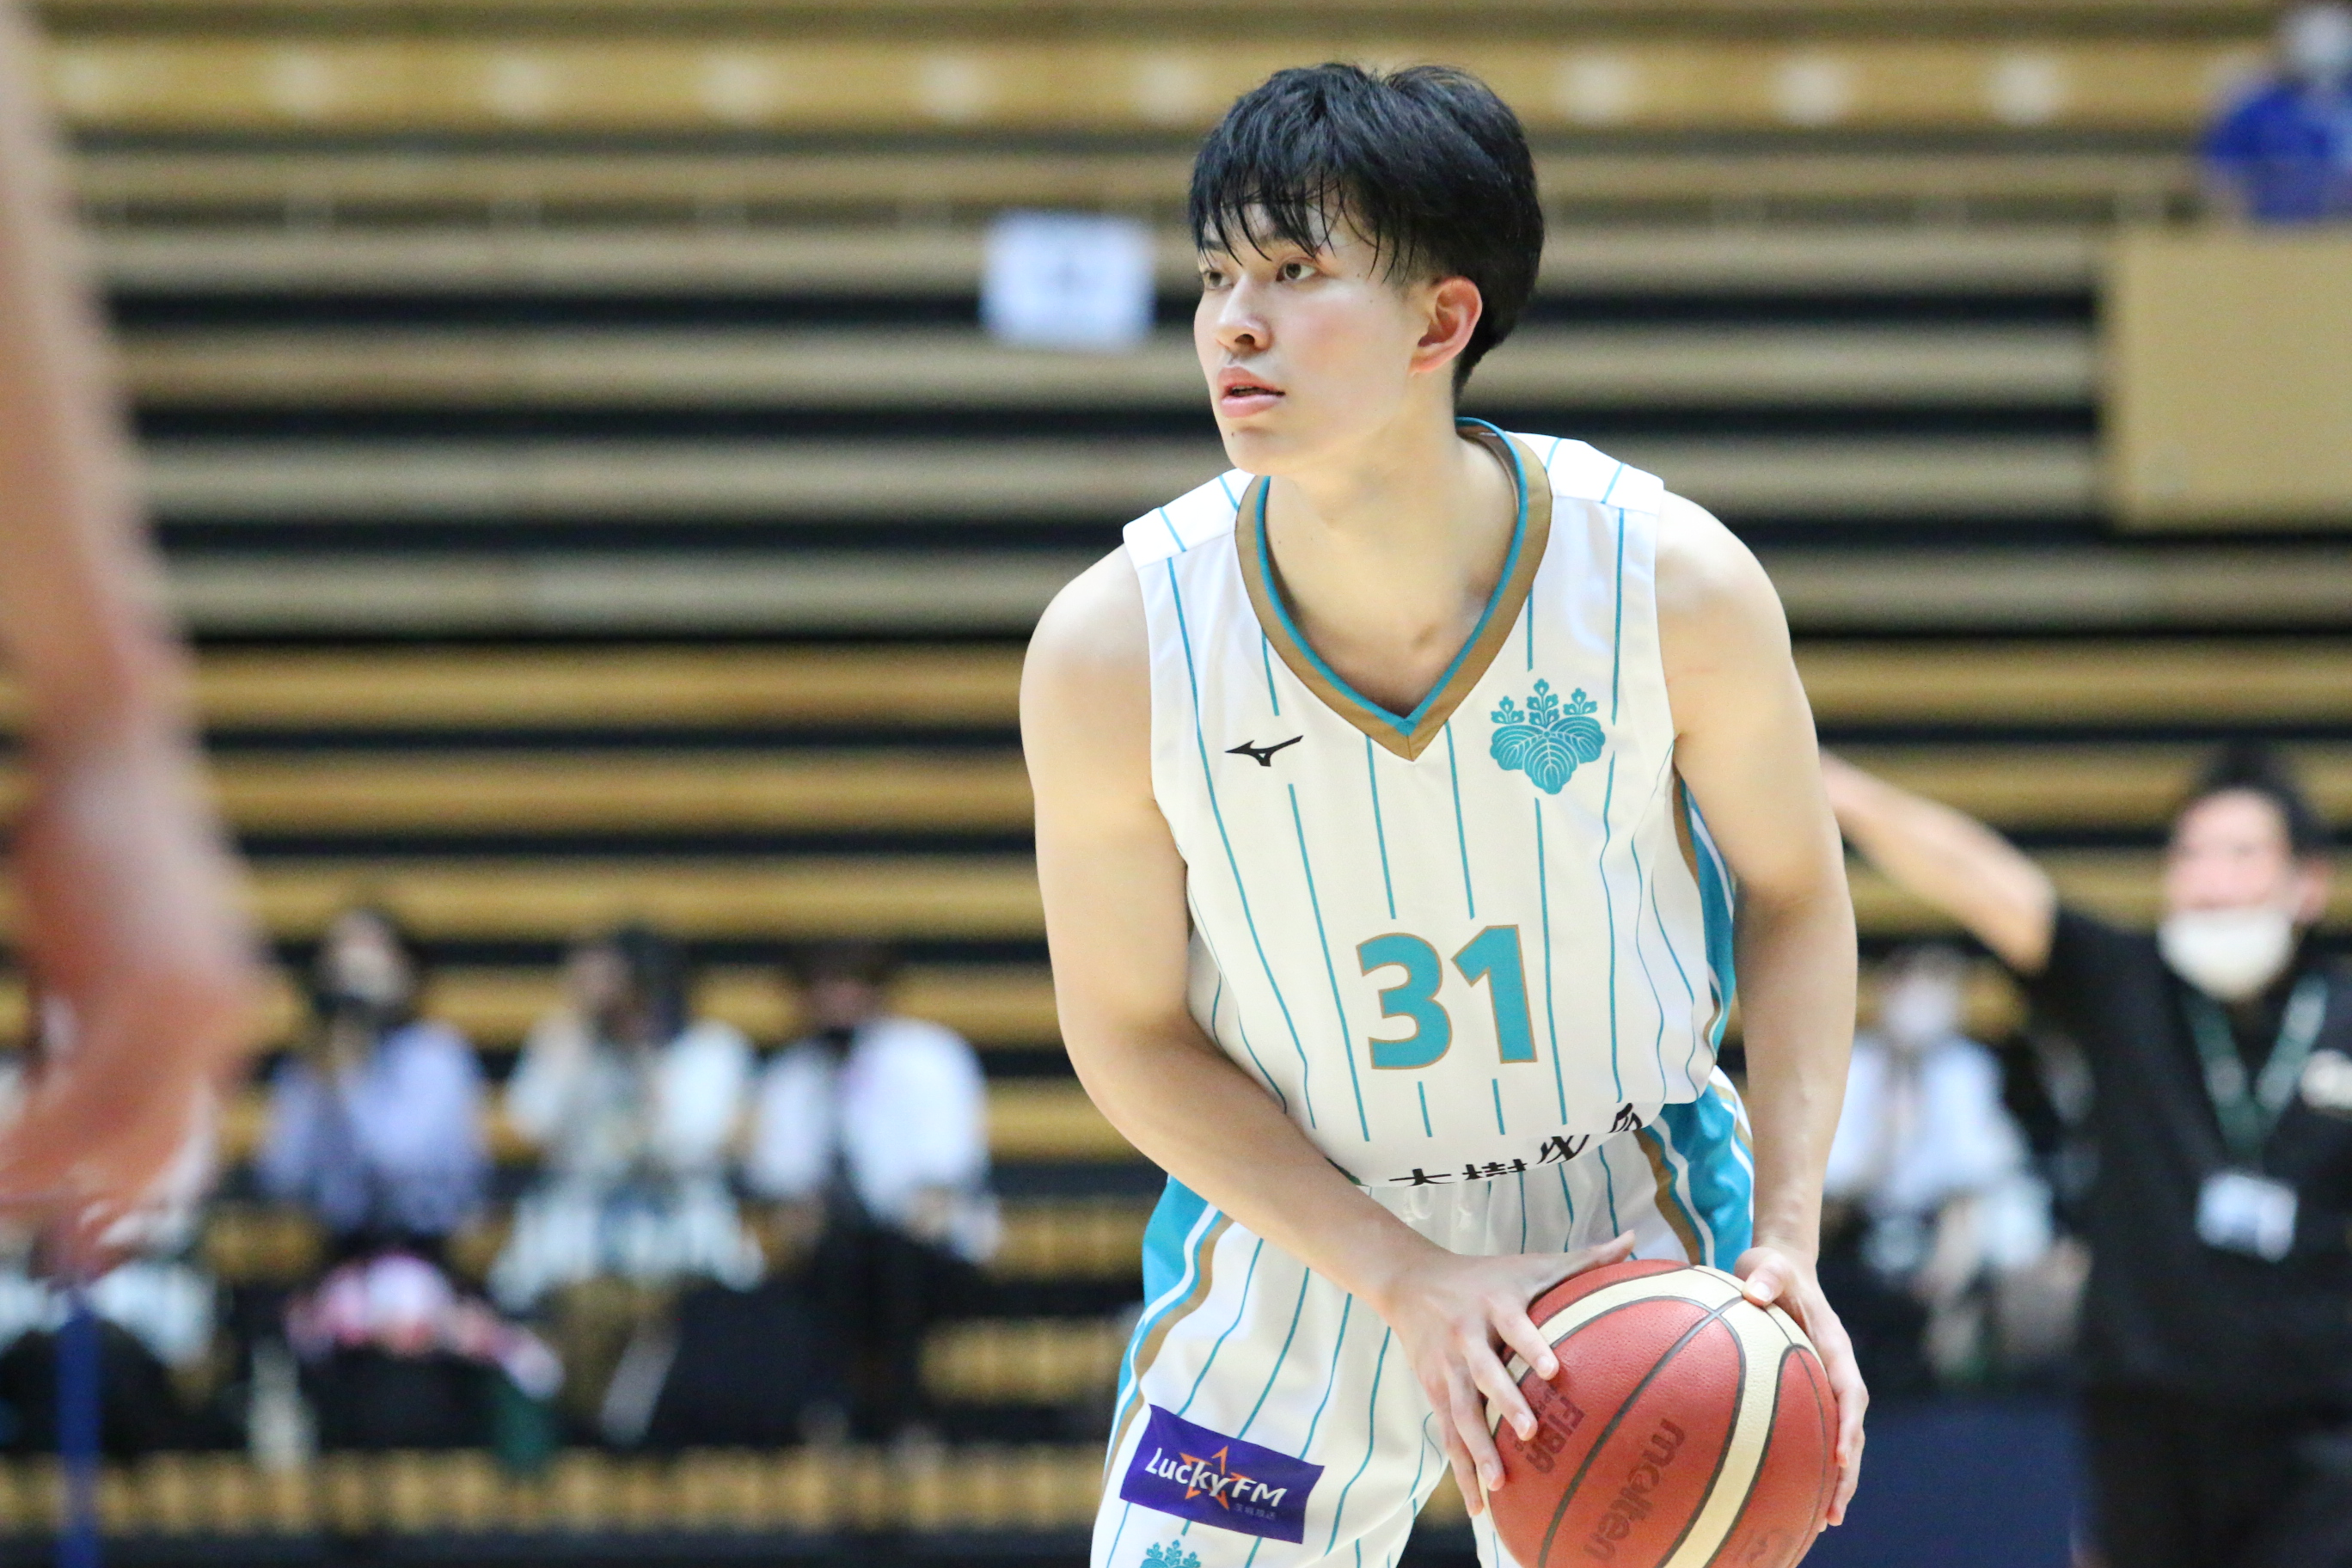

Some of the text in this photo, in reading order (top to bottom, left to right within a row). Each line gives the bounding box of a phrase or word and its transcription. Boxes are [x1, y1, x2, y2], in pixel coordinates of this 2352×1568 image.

[1356, 924, 1538, 1069] 31
[1526, 1396, 1585, 1474] FIBA
[1583, 1418, 1685, 1561] molten
